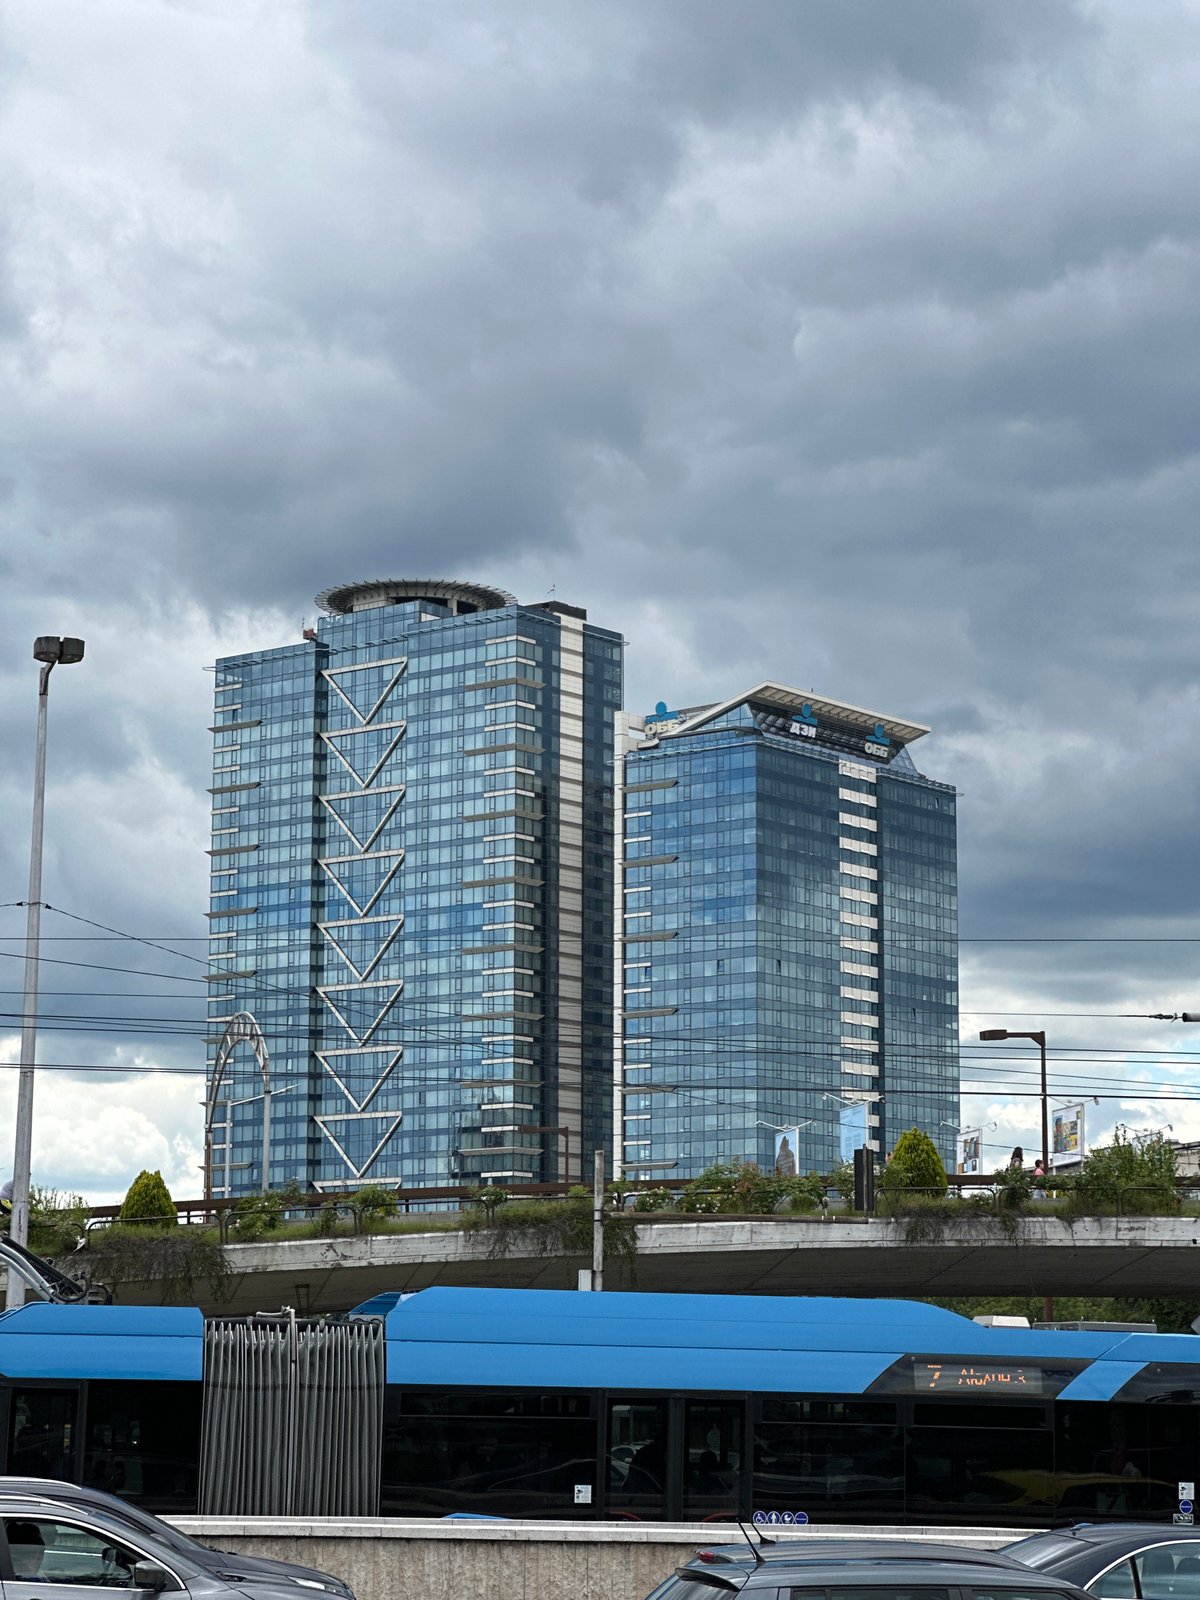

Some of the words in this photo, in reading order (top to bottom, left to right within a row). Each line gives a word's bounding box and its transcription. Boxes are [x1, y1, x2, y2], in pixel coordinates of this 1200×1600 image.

[645, 720, 679, 735] ОББ
[789, 722, 817, 738] ДЗИ
[864, 742, 889, 758] ОББ
[927, 1364, 942, 1388] 7
[1105, 1494, 1121, 1513] 7
